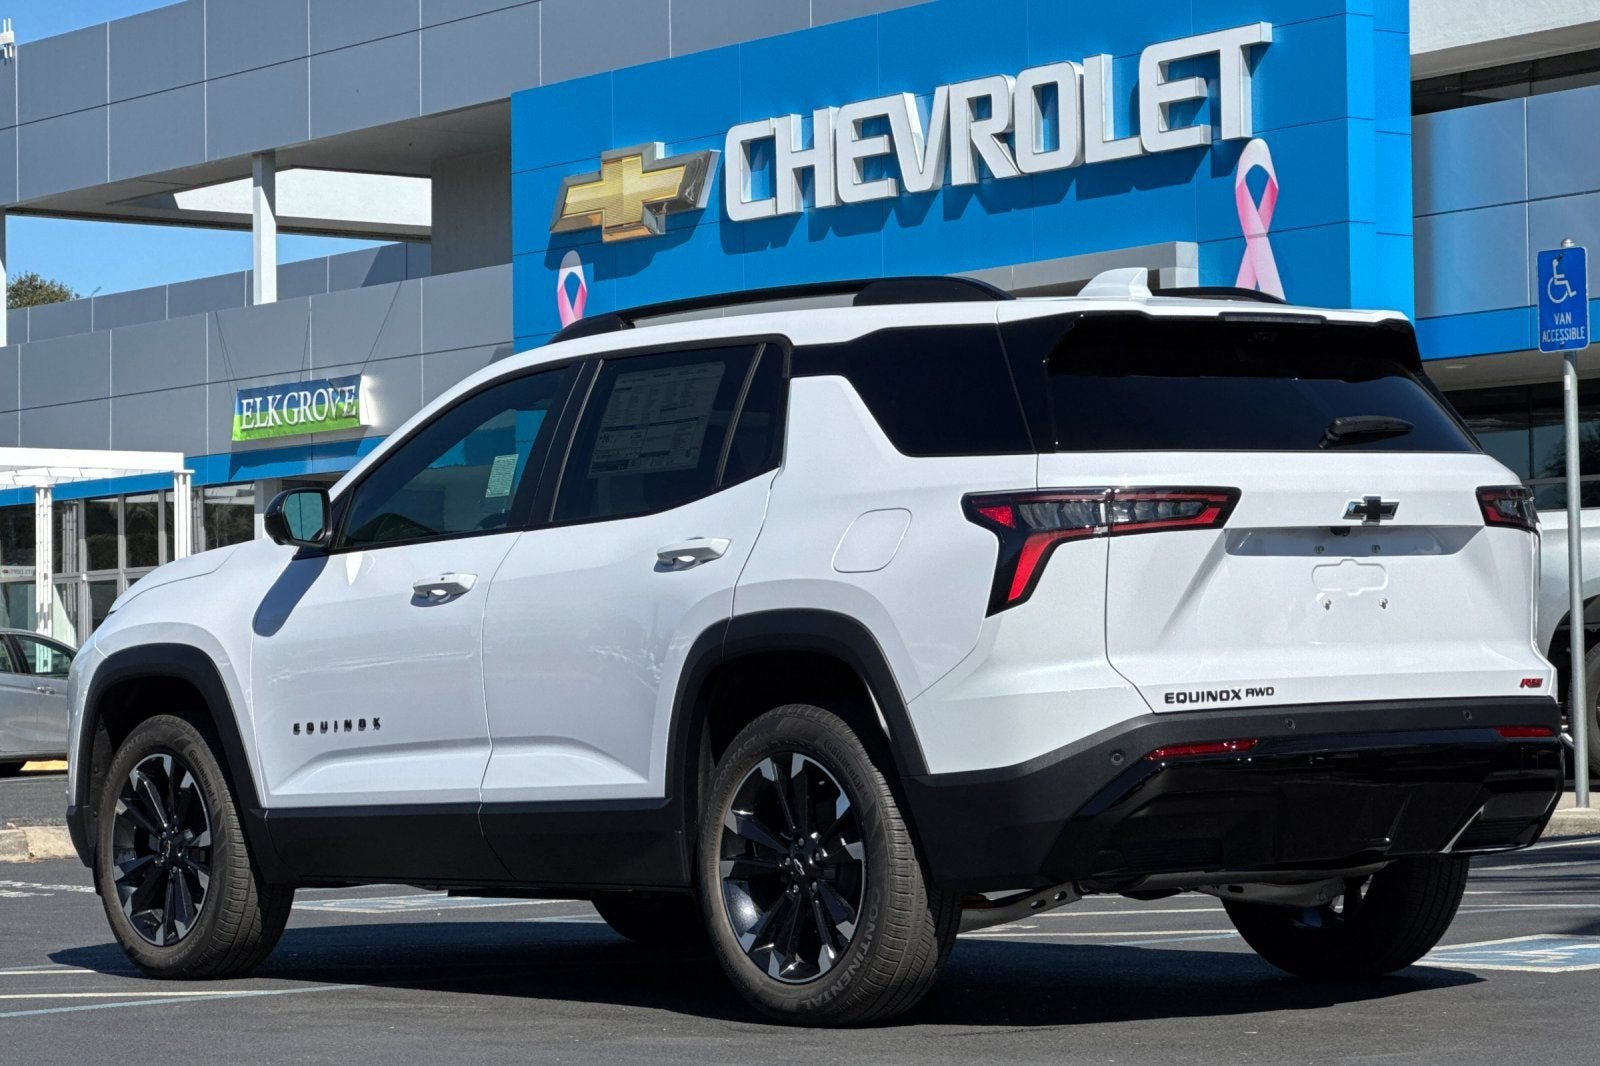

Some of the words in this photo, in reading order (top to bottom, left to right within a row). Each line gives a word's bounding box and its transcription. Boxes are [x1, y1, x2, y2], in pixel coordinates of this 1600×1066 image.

[725, 21, 1272, 222] CHEVROLET
[1553, 312, 1572, 325] VAN
[1542, 326, 1586, 343] ACCESSIBLE
[240, 394, 283, 430] ELK
[282, 385, 357, 426] GROVE
[1164, 688, 1242, 705] EQUINOX
[1245, 686, 1275, 698] AWD
[292, 717, 381, 736] EQUINOX
